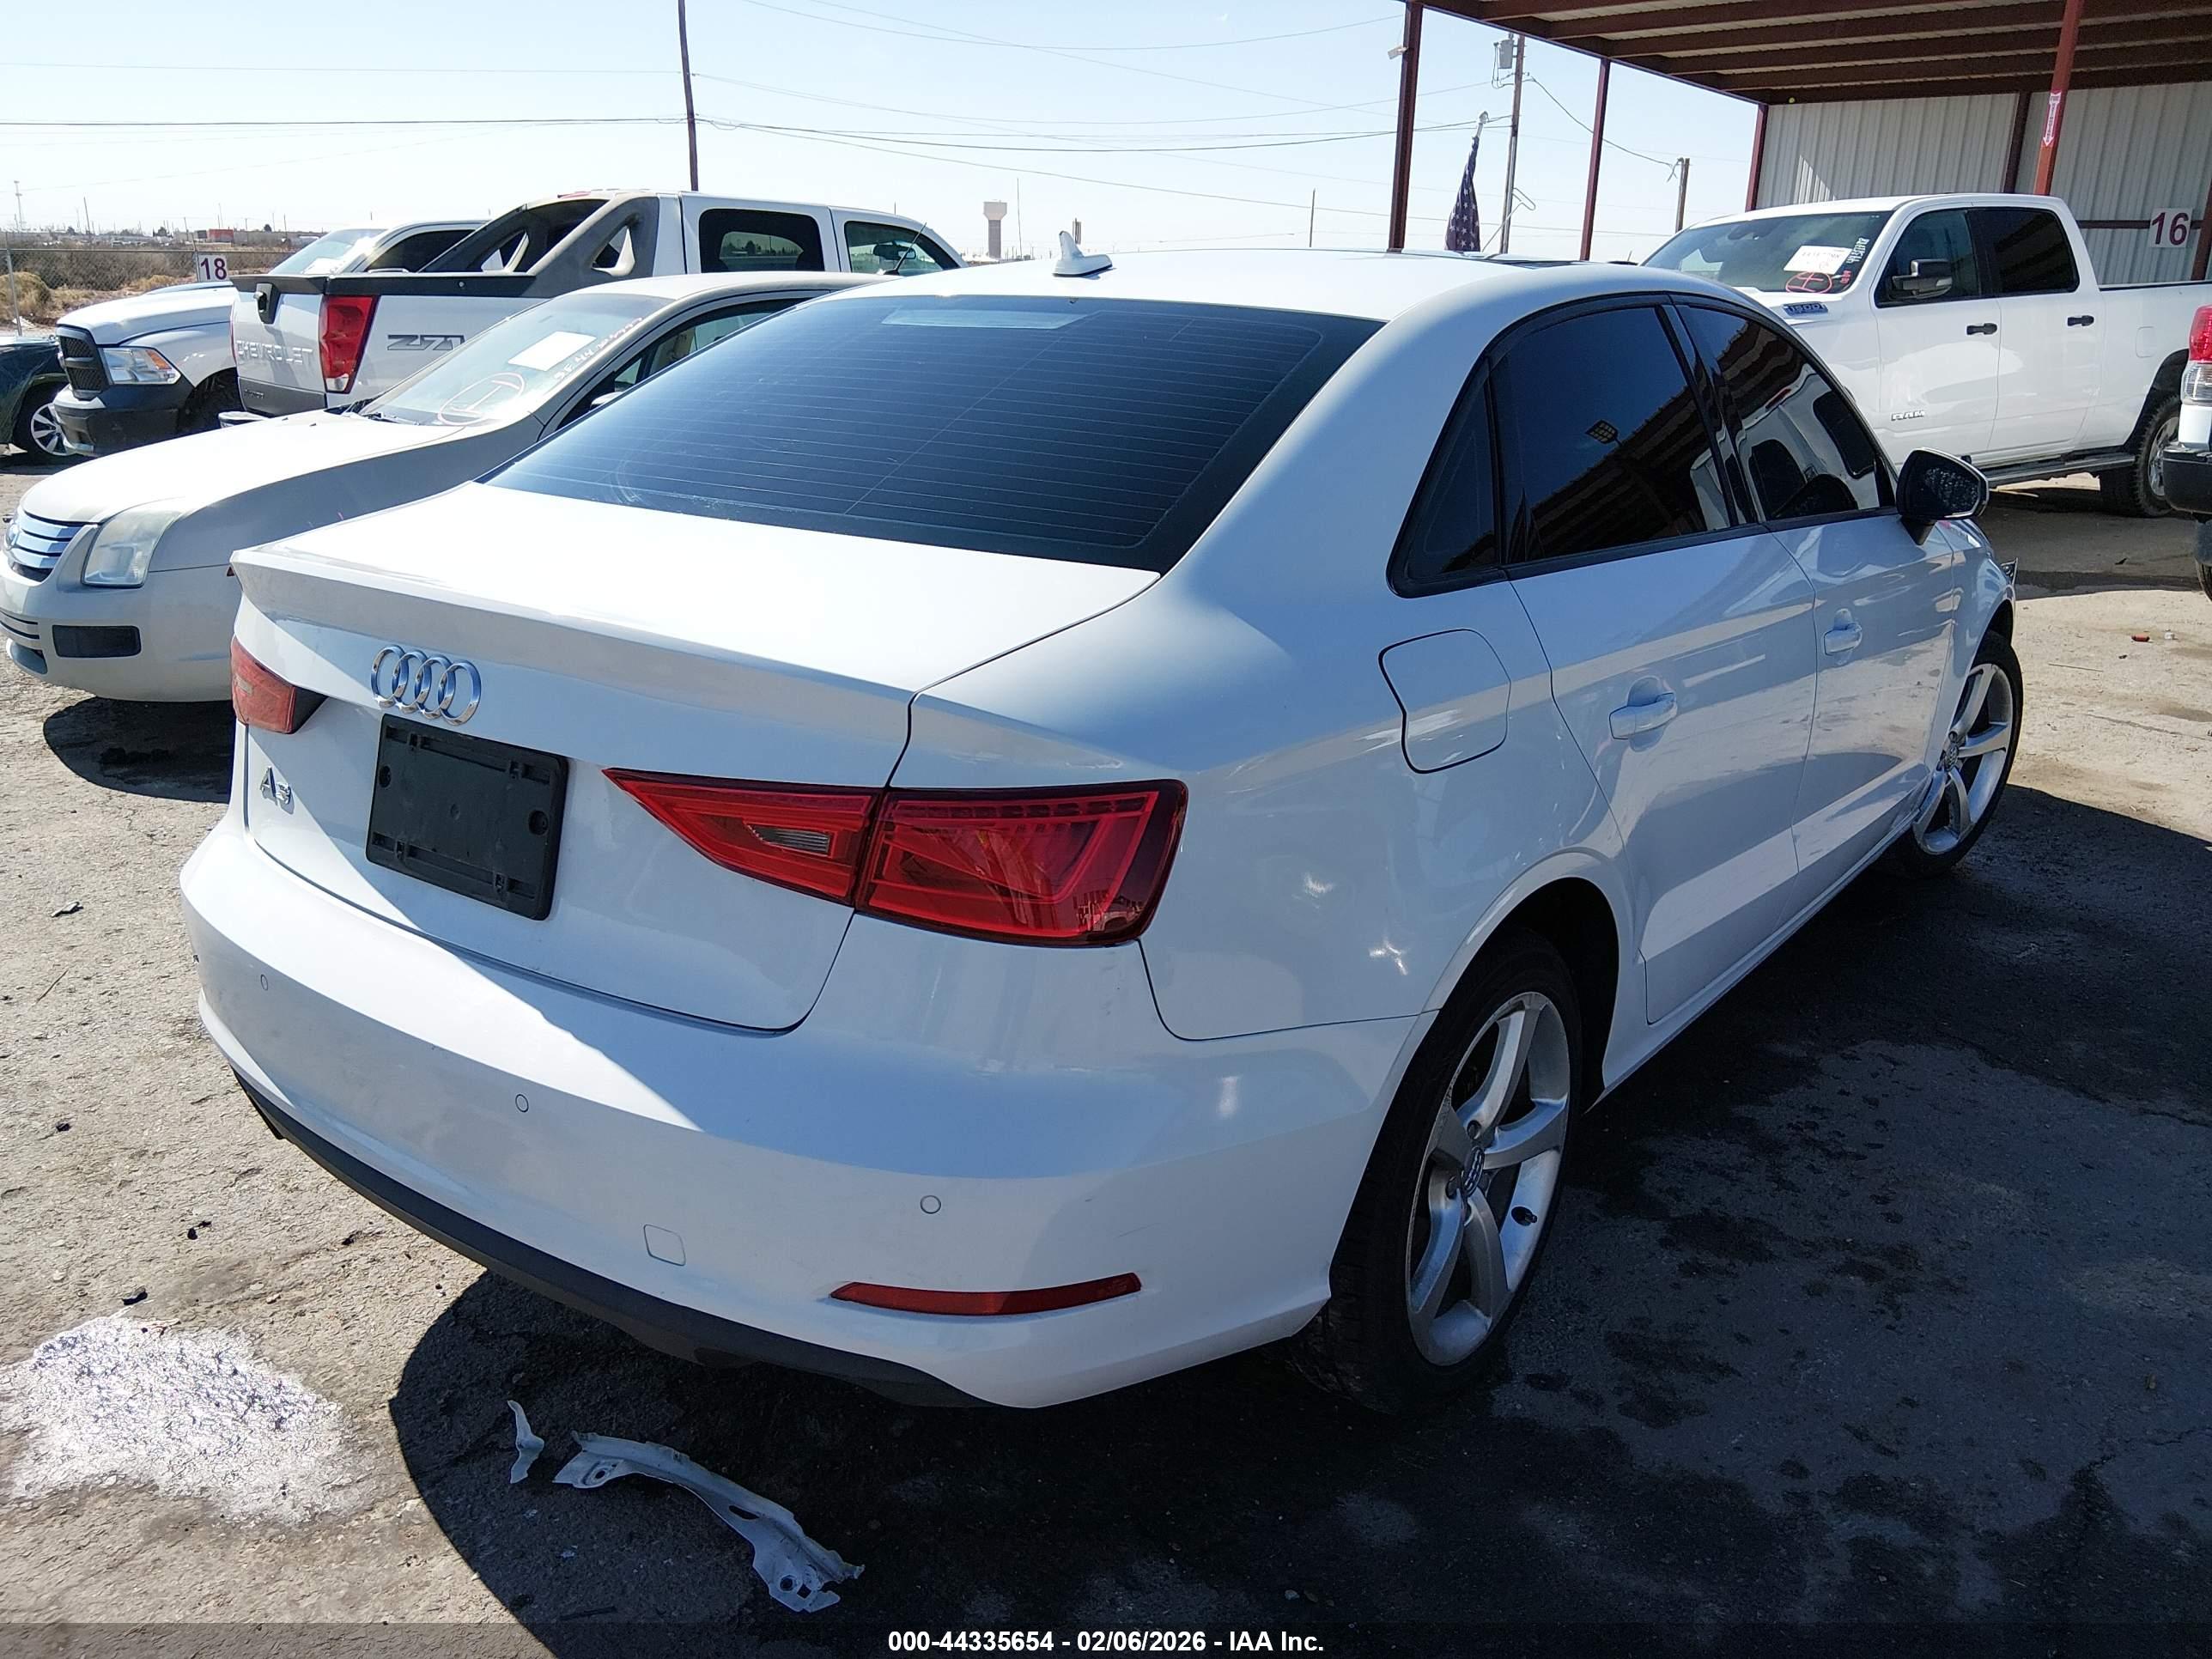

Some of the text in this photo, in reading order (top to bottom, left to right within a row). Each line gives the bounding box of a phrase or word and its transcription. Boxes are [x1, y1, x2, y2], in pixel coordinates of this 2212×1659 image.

[2152, 212, 2189, 246] 16
[200, 258, 228, 280] 18
[236, 340, 314, 364] CHEVROLET
[387, 335, 465, 351] Z71
[1891, 410, 1925, 422] RAM
[260, 766, 292, 805] A3
